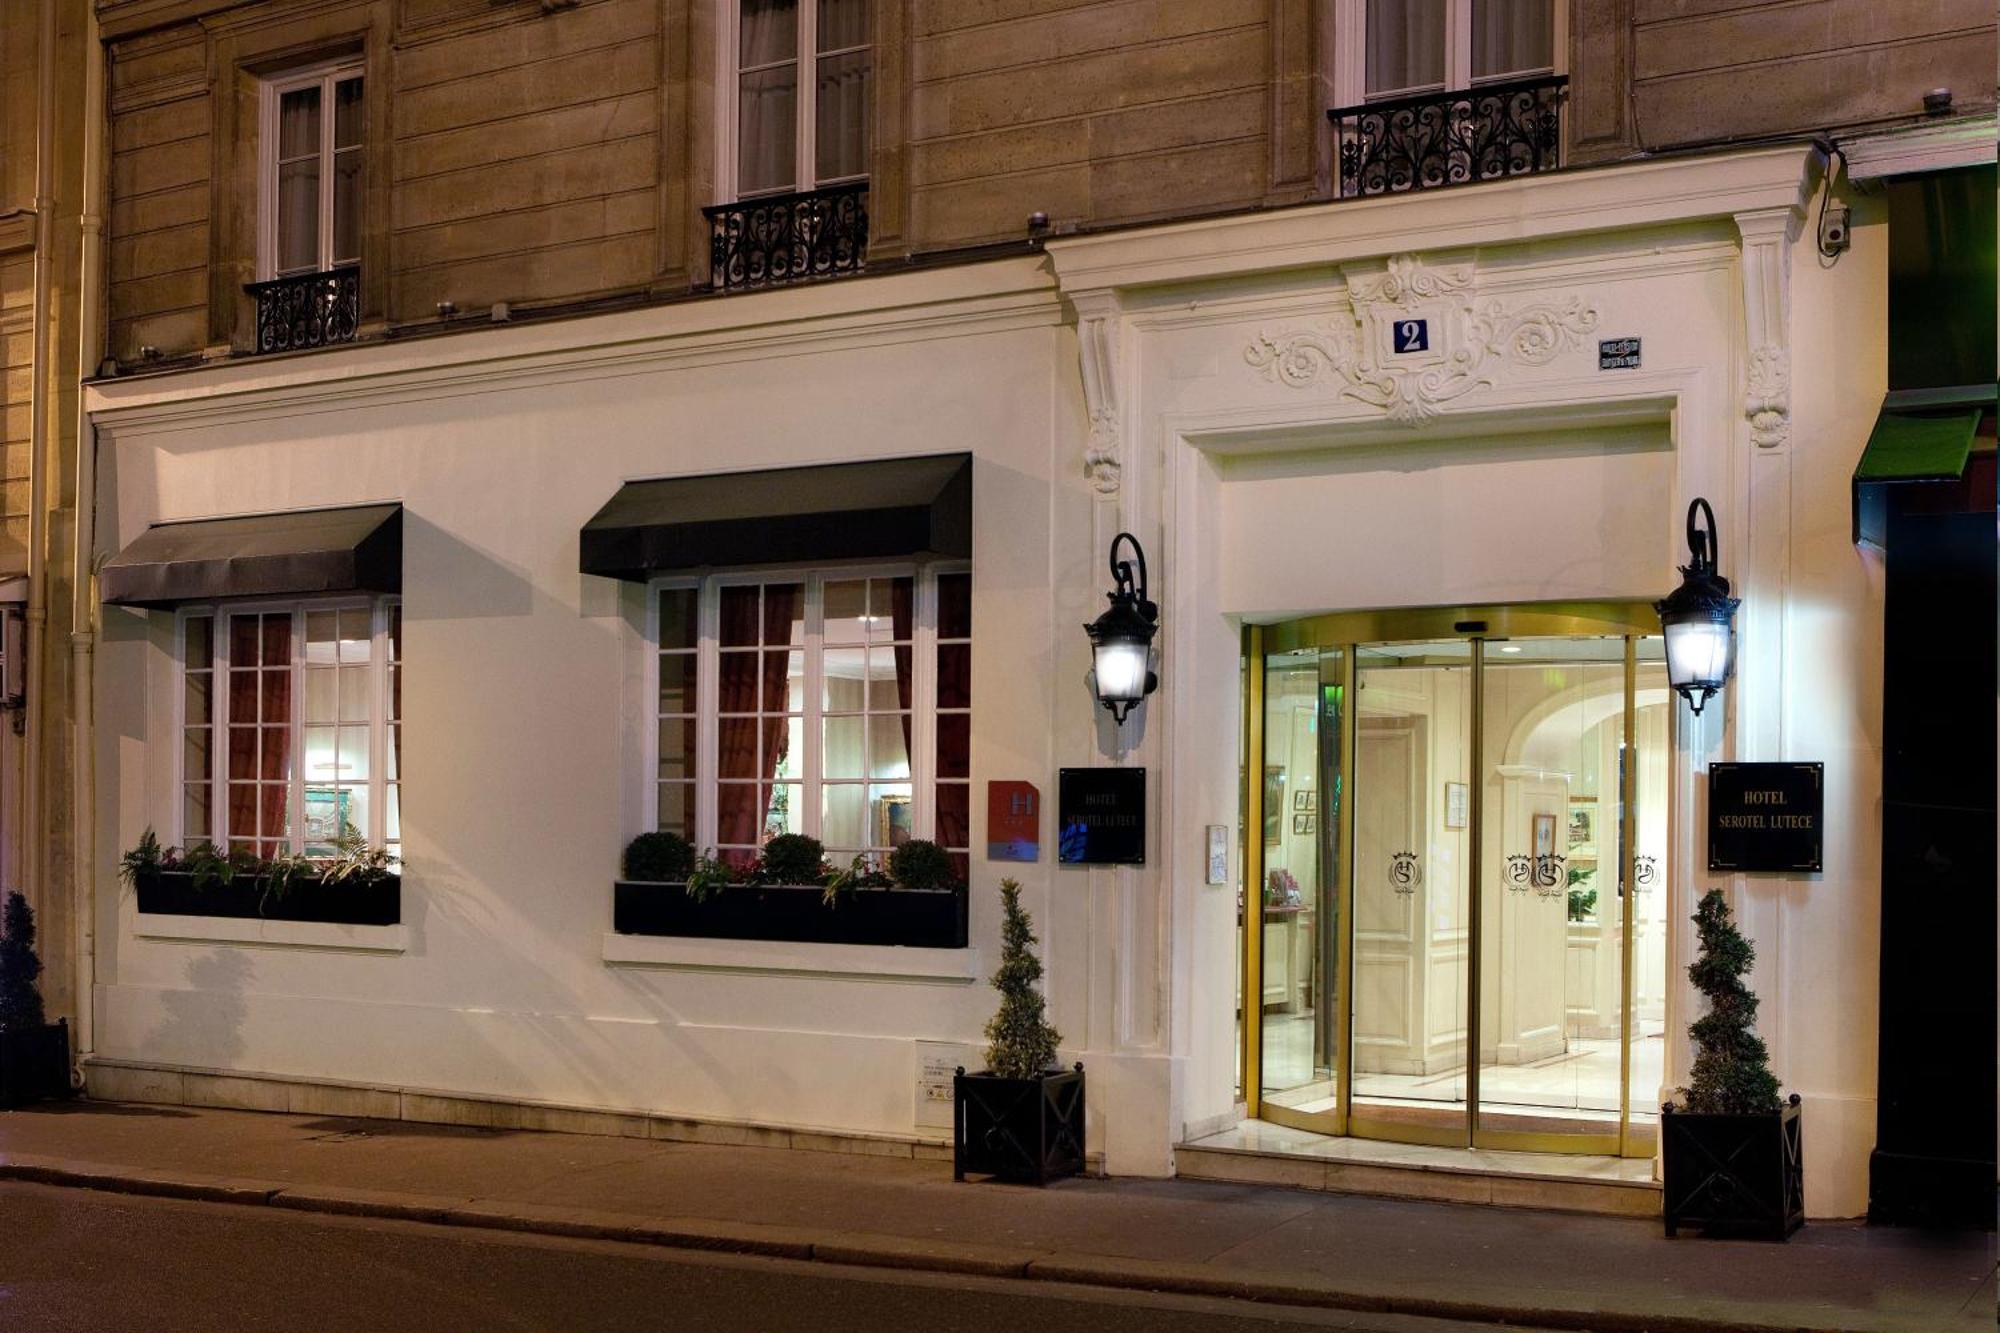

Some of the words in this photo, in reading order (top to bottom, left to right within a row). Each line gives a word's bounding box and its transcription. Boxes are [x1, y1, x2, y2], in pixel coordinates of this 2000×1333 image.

[1402, 321, 1420, 351] 2
[1010, 790, 1033, 816] H
[1744, 791, 1787, 805] HOTEL
[1719, 815, 1766, 829] SEROTEL
[1771, 815, 1813, 829] LUTECE
